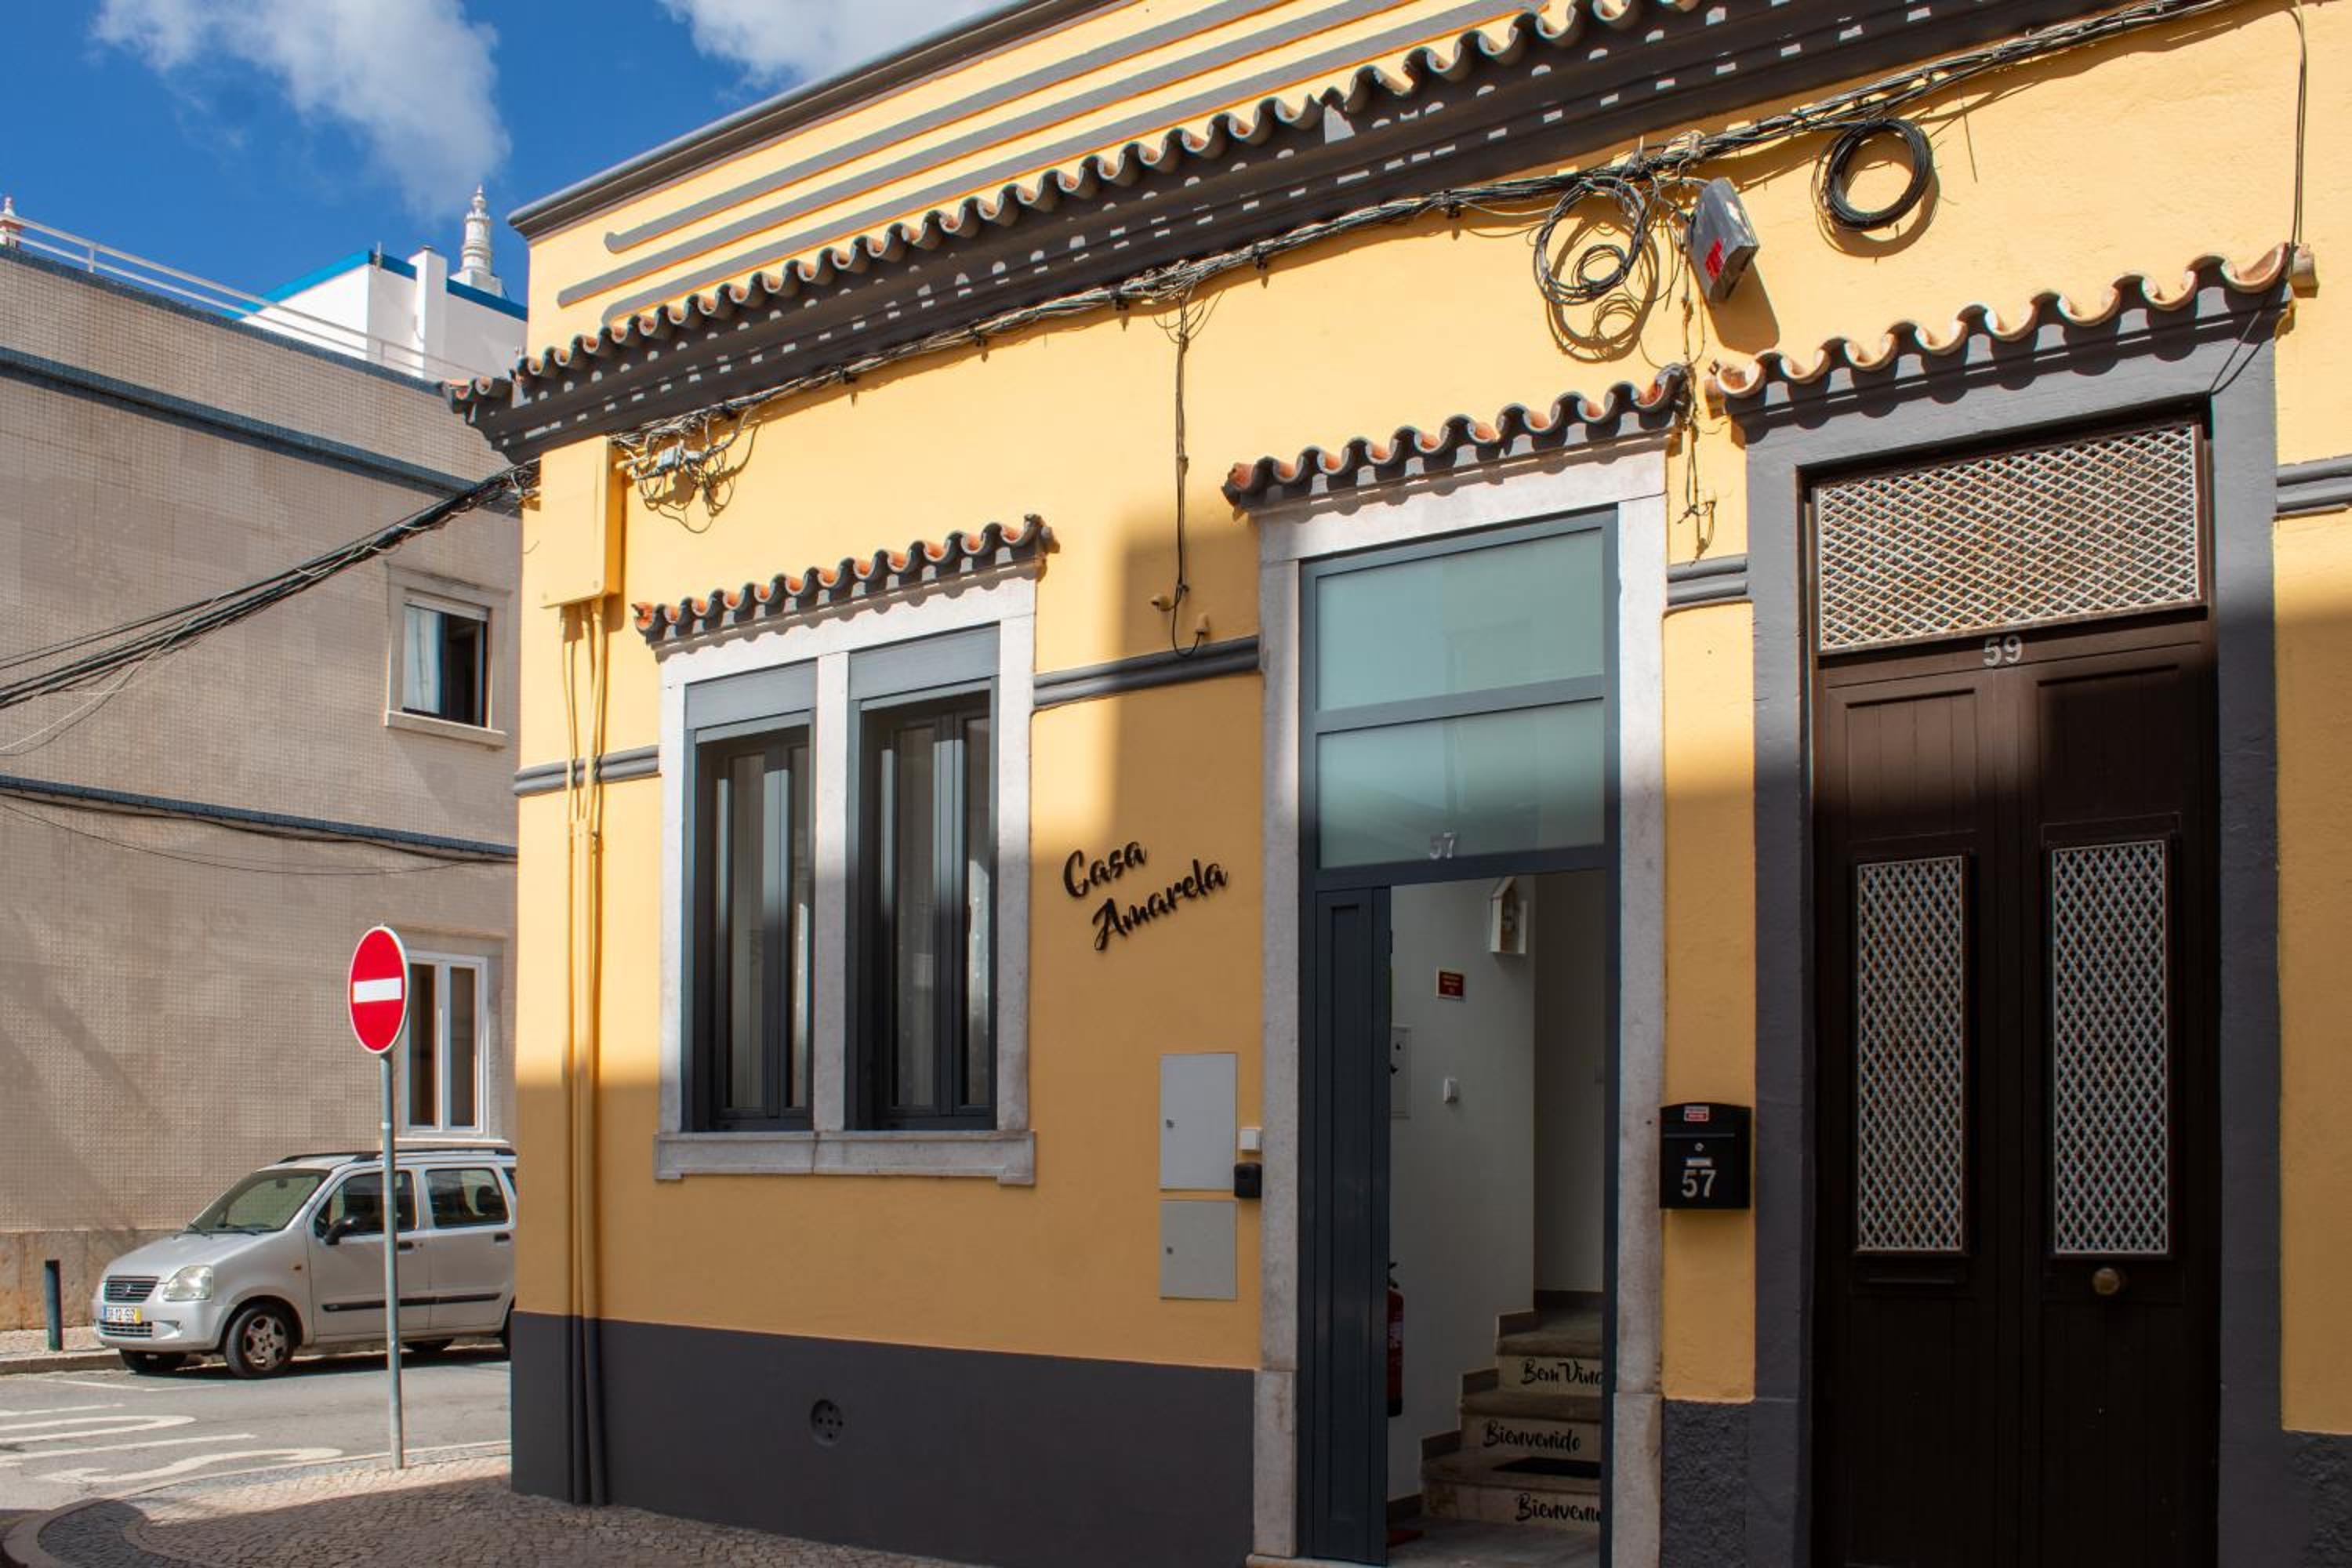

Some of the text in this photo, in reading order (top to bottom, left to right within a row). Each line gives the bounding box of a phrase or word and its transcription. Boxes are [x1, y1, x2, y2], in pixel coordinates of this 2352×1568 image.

[1984, 634, 2022, 666] 59
[1429, 831, 1456, 860] 57
[1063, 841, 1147, 898] Casa
[1092, 859, 1229, 951] Amarela
[1682, 1169, 1716, 1198] 57
[1521, 1357, 1559, 1385] Bem
[1483, 1420, 1581, 1452] Bienvenido
